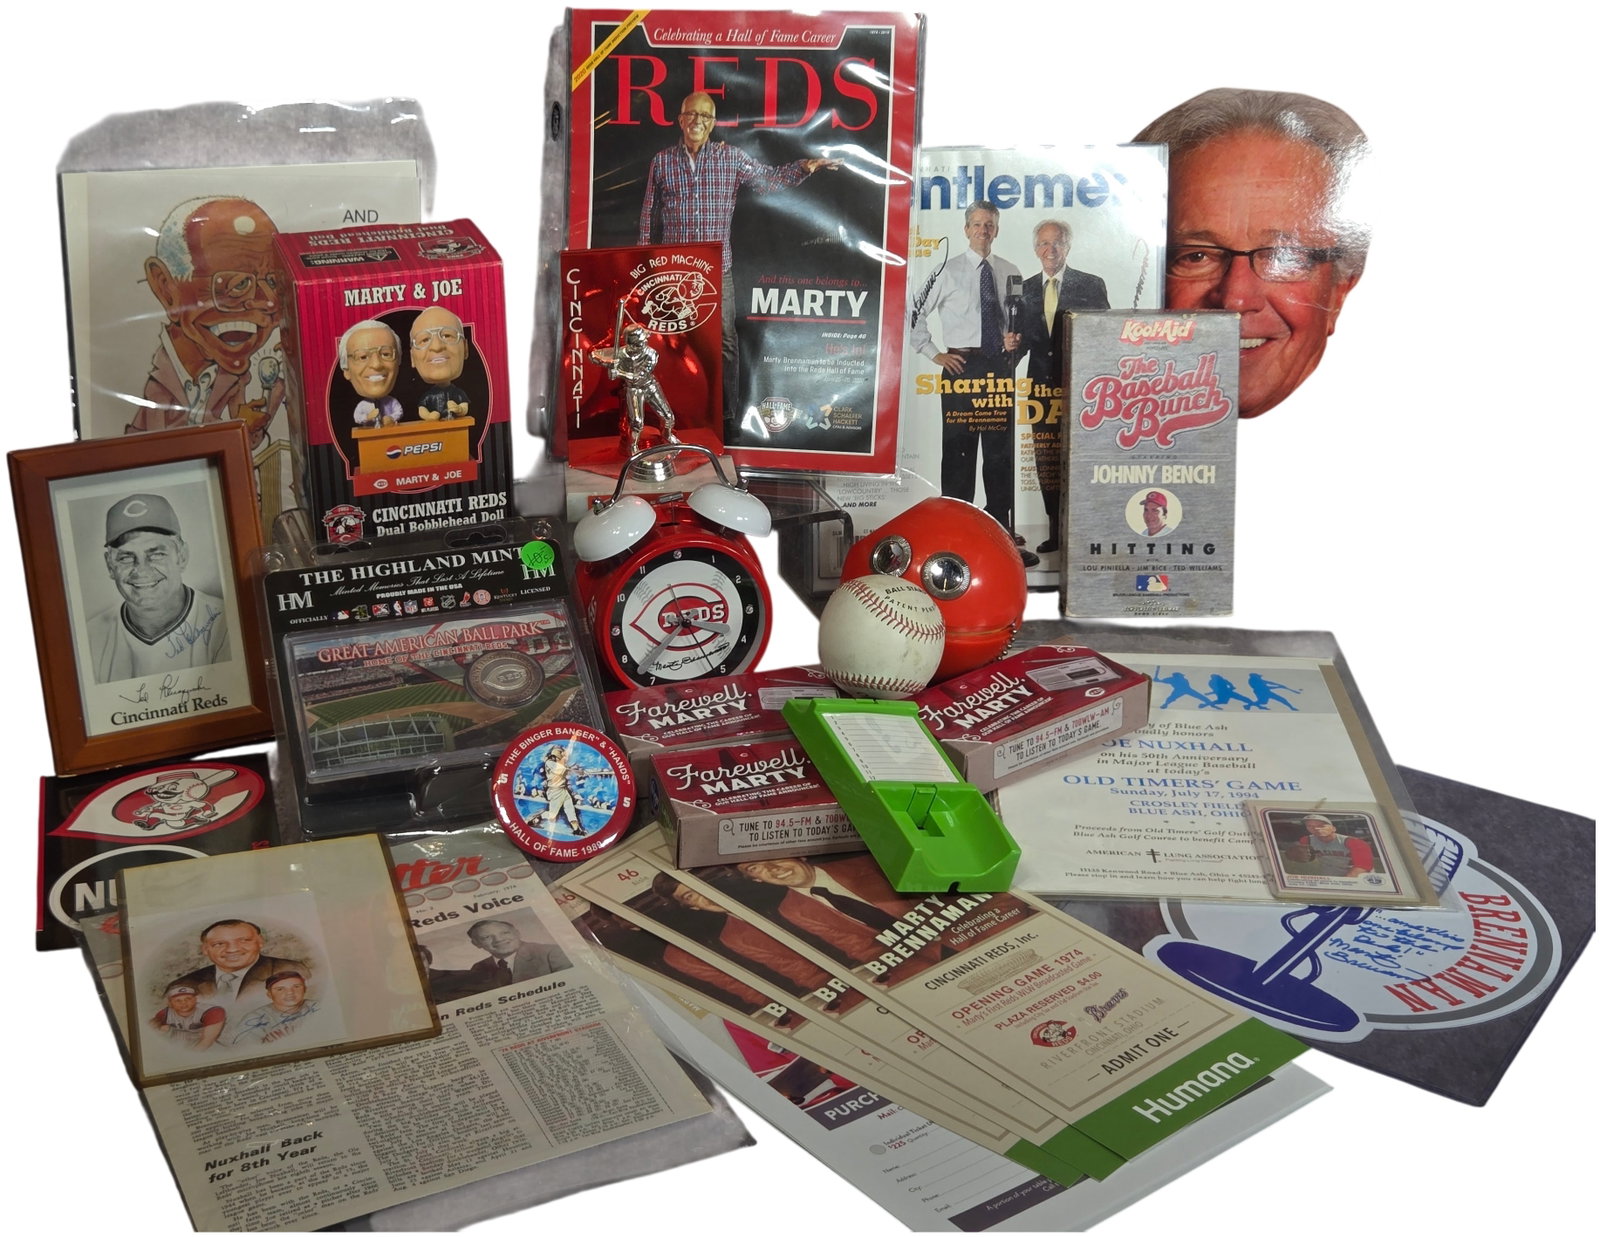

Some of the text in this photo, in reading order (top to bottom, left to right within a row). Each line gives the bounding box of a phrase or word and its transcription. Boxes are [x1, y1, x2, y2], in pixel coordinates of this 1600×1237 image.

[654, 28, 836, 45] Celebrating a Hall of Fame Career
[608, 55, 878, 131] REDS
[343, 210, 379, 223] AND
[629, 254, 714, 279] BIG RED MACHINE
[344, 278, 462, 307] MARTY & JOE
[637, 274, 683, 296] CINCINNATI
[751, 288, 868, 317] MARTY
[648, 319, 688, 332] REDS
[566, 268, 584, 428] CINCINNATI
[1118, 354, 1159, 380] The
[915, 373, 1033, 397] Sharing
[1034, 384, 1062, 398] the
[1080, 352, 1220, 430] Baseball
[972, 393, 1013, 408] with
[1116, 388, 1232, 450] Bunch
[403, 442, 443, 455] PEPSI
[396, 475, 429, 486] MARTY
[444, 470, 462, 480] JOE
[1090, 464, 1216, 484] JOHNNY BENCH
[372, 492, 507, 523] CINCINNATI REDS
[377, 509, 504, 537] Dual Bobblehead Doll
[1090, 543, 1216, 555] HITTING
[299, 568, 344, 586] THE
[350, 554, 465, 580] HIGHLAND
[472, 547, 523, 565] MINT
[277, 590, 314, 612] HM
[520, 586, 550, 594] LICENSED
[290, 615, 328, 624] OFFICIALLY
[317, 644, 371, 663] GREAT
[375, 631, 458, 656] AMERICAN
[464, 626, 498, 642] BALL
[720, 665, 726, 673] 5
[111, 694, 228, 726] Cincinnati Reds
[648, 699, 748, 730] MARTY
[954, 685, 1034, 729] MARTY
[1008, 707, 1110, 754] TUNE TO 94.5-FM & 700WLW-AM
[1133, 728, 1214, 737] oudly honors
[1158, 722, 1171, 730] of
[1175, 722, 1202, 730] Blue
[520, 729, 553, 749] BINGER
[1138, 740, 1253, 752] NUXHALL
[1112, 758, 1144, 767] Major
[1147, 760, 1198, 769] League
[1142, 752, 1168, 760] 50th
[1173, 753, 1249, 763] Anniversary
[500, 773, 508, 784] 5
[701, 766, 806, 795] MARTY
[1063, 775, 1302, 791] OLD TIMERS' GAME
[1164, 768, 1210, 776] today's
[623, 797, 631, 807] 5
[1110, 788, 1168, 798] Sunday,
[1172, 789, 1200, 799] July
[1205, 791, 1224, 799] 17,
[1129, 800, 1246, 810] CROSLEY FIELD
[740, 822, 759, 832] TUNE
[764, 821, 773, 830] TO
[775, 815, 812, 828] 94.5-FM
[815, 815, 821, 824] &
[1128, 808, 1251, 818] BLUE ASH, OHIO
[510, 822, 531, 846] HALL
[533, 842, 547, 852] OF
[550, 848, 578, 857] FAME
[749, 832, 759, 841] TO
[762, 828, 789, 841] LISTEN
[793, 828, 803, 836] TO
[806, 824, 839, 836] TODAY'S
[617, 868, 640, 882] 46
[411, 894, 525, 928] Reds Voice
[875, 894, 946, 948] MARTY
[951, 909, 995, 933] Celebrating
[864, 892, 993, 976] BRENNAMAN
[950, 908, 1021, 946] Hall of Fame Career
[924, 931, 1039, 991] CINCINNATI REDS, Inc.
[1384, 891, 1528, 1013] BRENNAMAN
[951, 985, 1014, 1020] OPENING
[1014, 964, 1055, 987] GAME
[1054, 949, 1084, 966] 1974
[455, 1002, 493, 1016] Reds
[497, 980, 566, 1005] Schedule
[995, 971, 1102, 1031] PLAZA RESERVED $4.00
[1084, 988, 1129, 1024] Braves
[1040, 1027, 1108, 1070] RIVERFRONT
[1113, 997, 1164, 1027] STADIUM
[1101, 1027, 1179, 1076] ADMIT ONE
[1132, 1050, 1255, 1124] Humana
[204, 1130, 324, 1171] Nuxhall Back
[208, 1145, 317, 1183] for 8th Year
